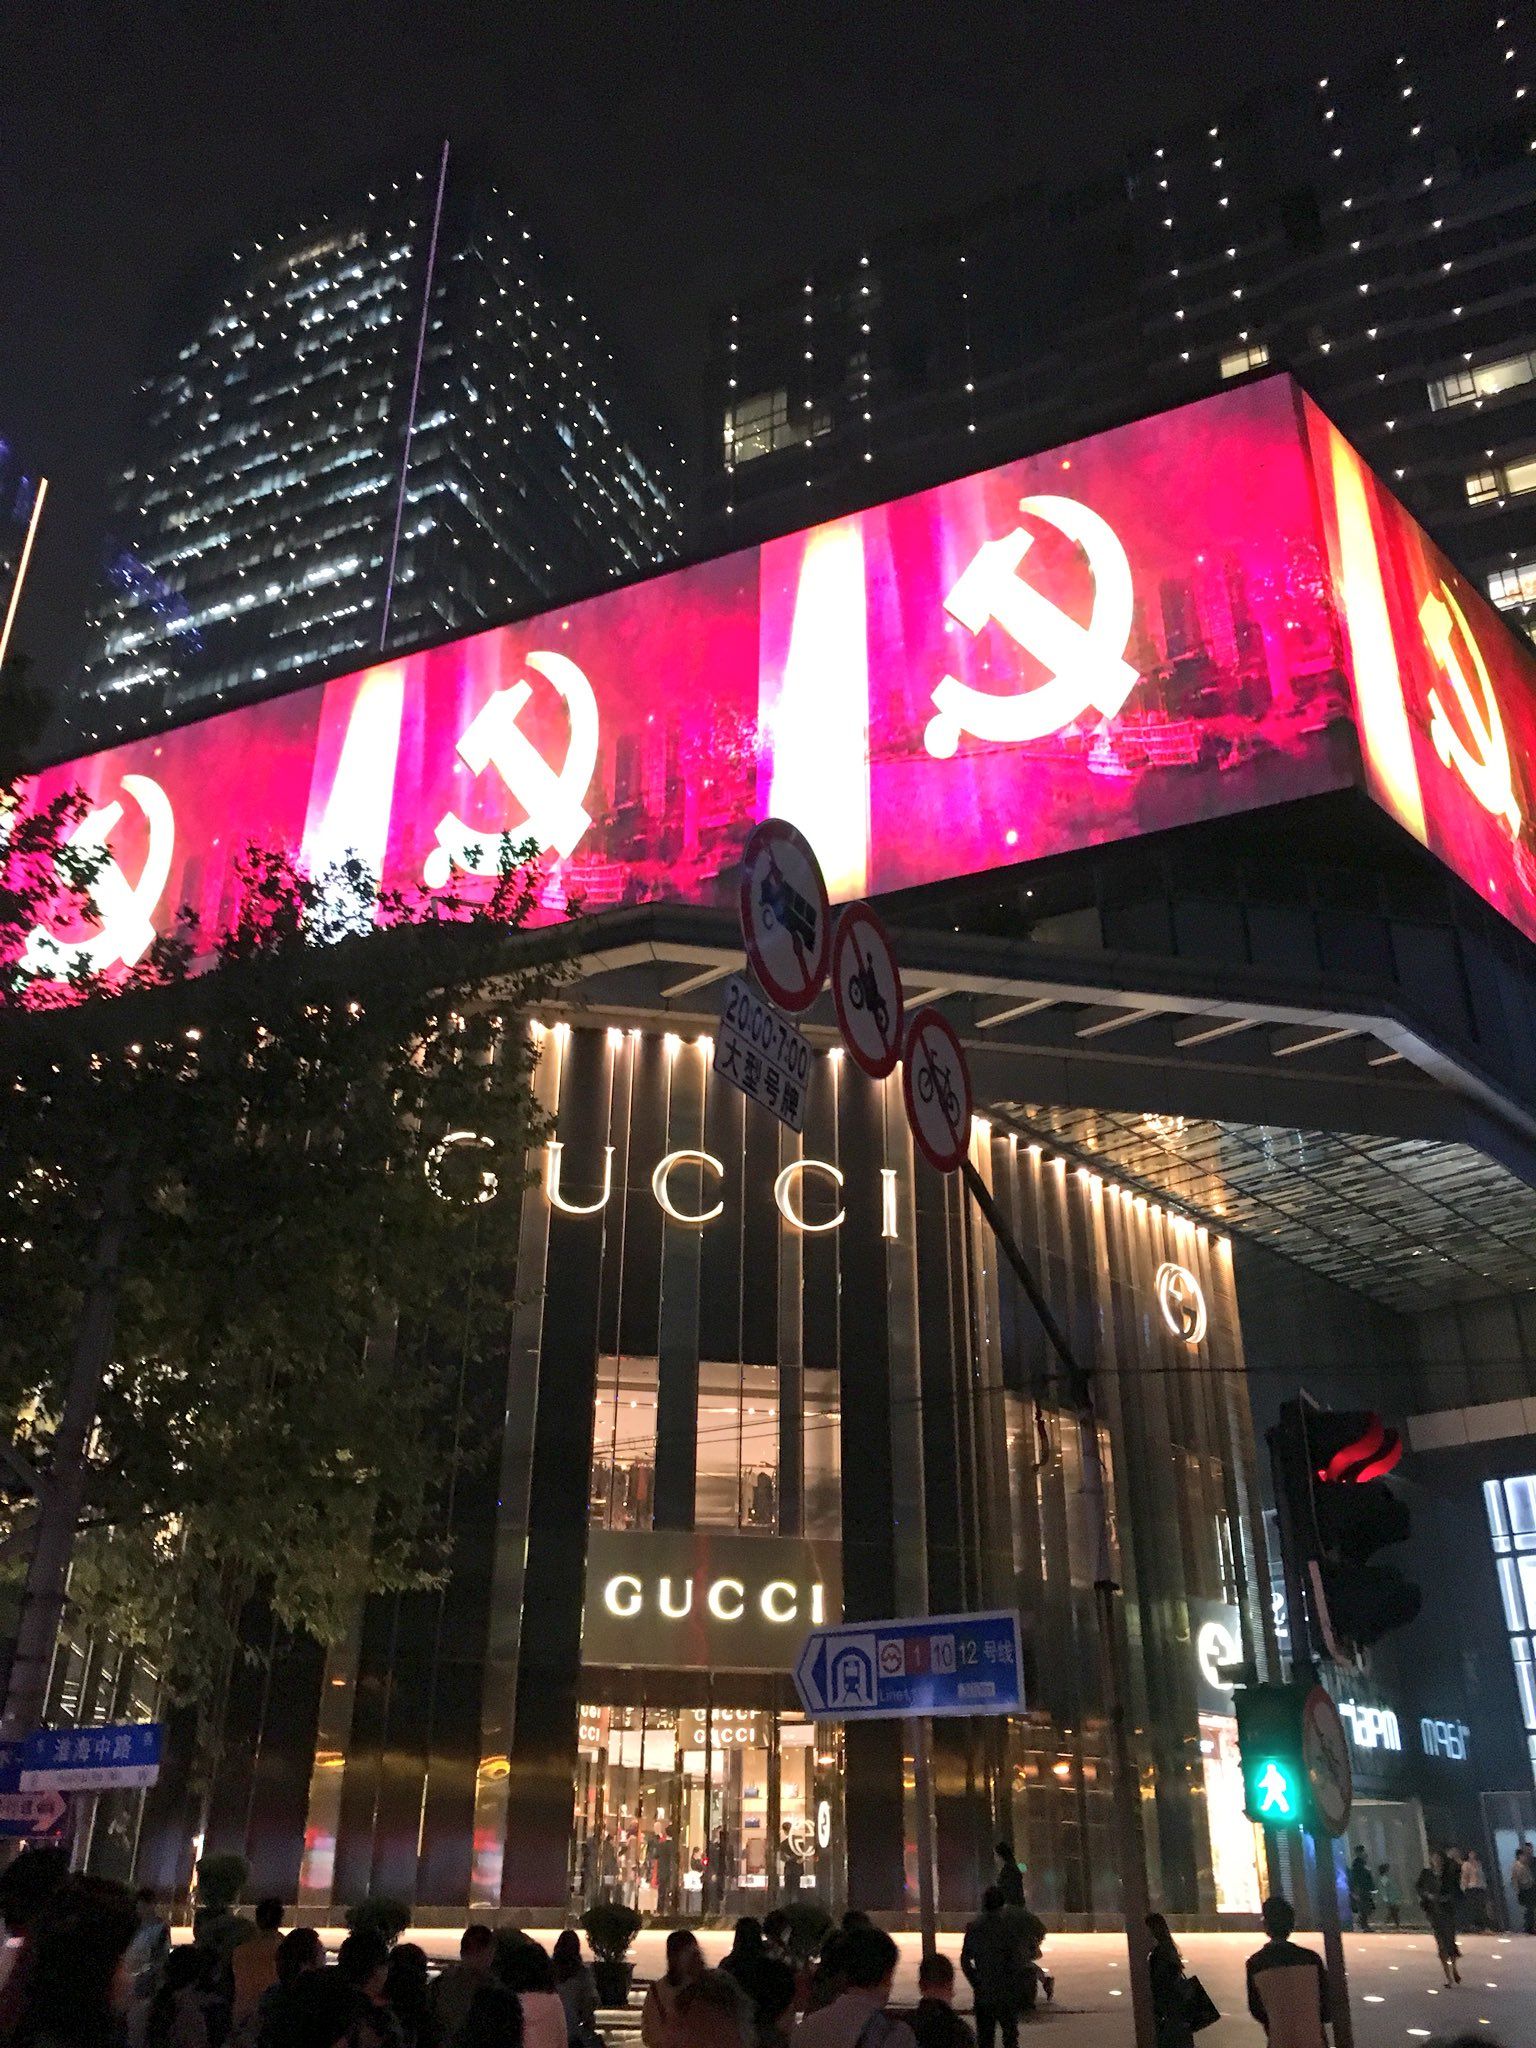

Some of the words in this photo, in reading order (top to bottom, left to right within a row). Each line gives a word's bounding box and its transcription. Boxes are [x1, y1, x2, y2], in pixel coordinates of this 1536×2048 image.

[721, 1037, 800, 1122] 大型号牌
[423, 1130, 898, 1239] GUCCI
[604, 1575, 825, 1625] GUCCI
[933, 1642, 954, 1667] 10
[959, 1639, 979, 1665] 12
